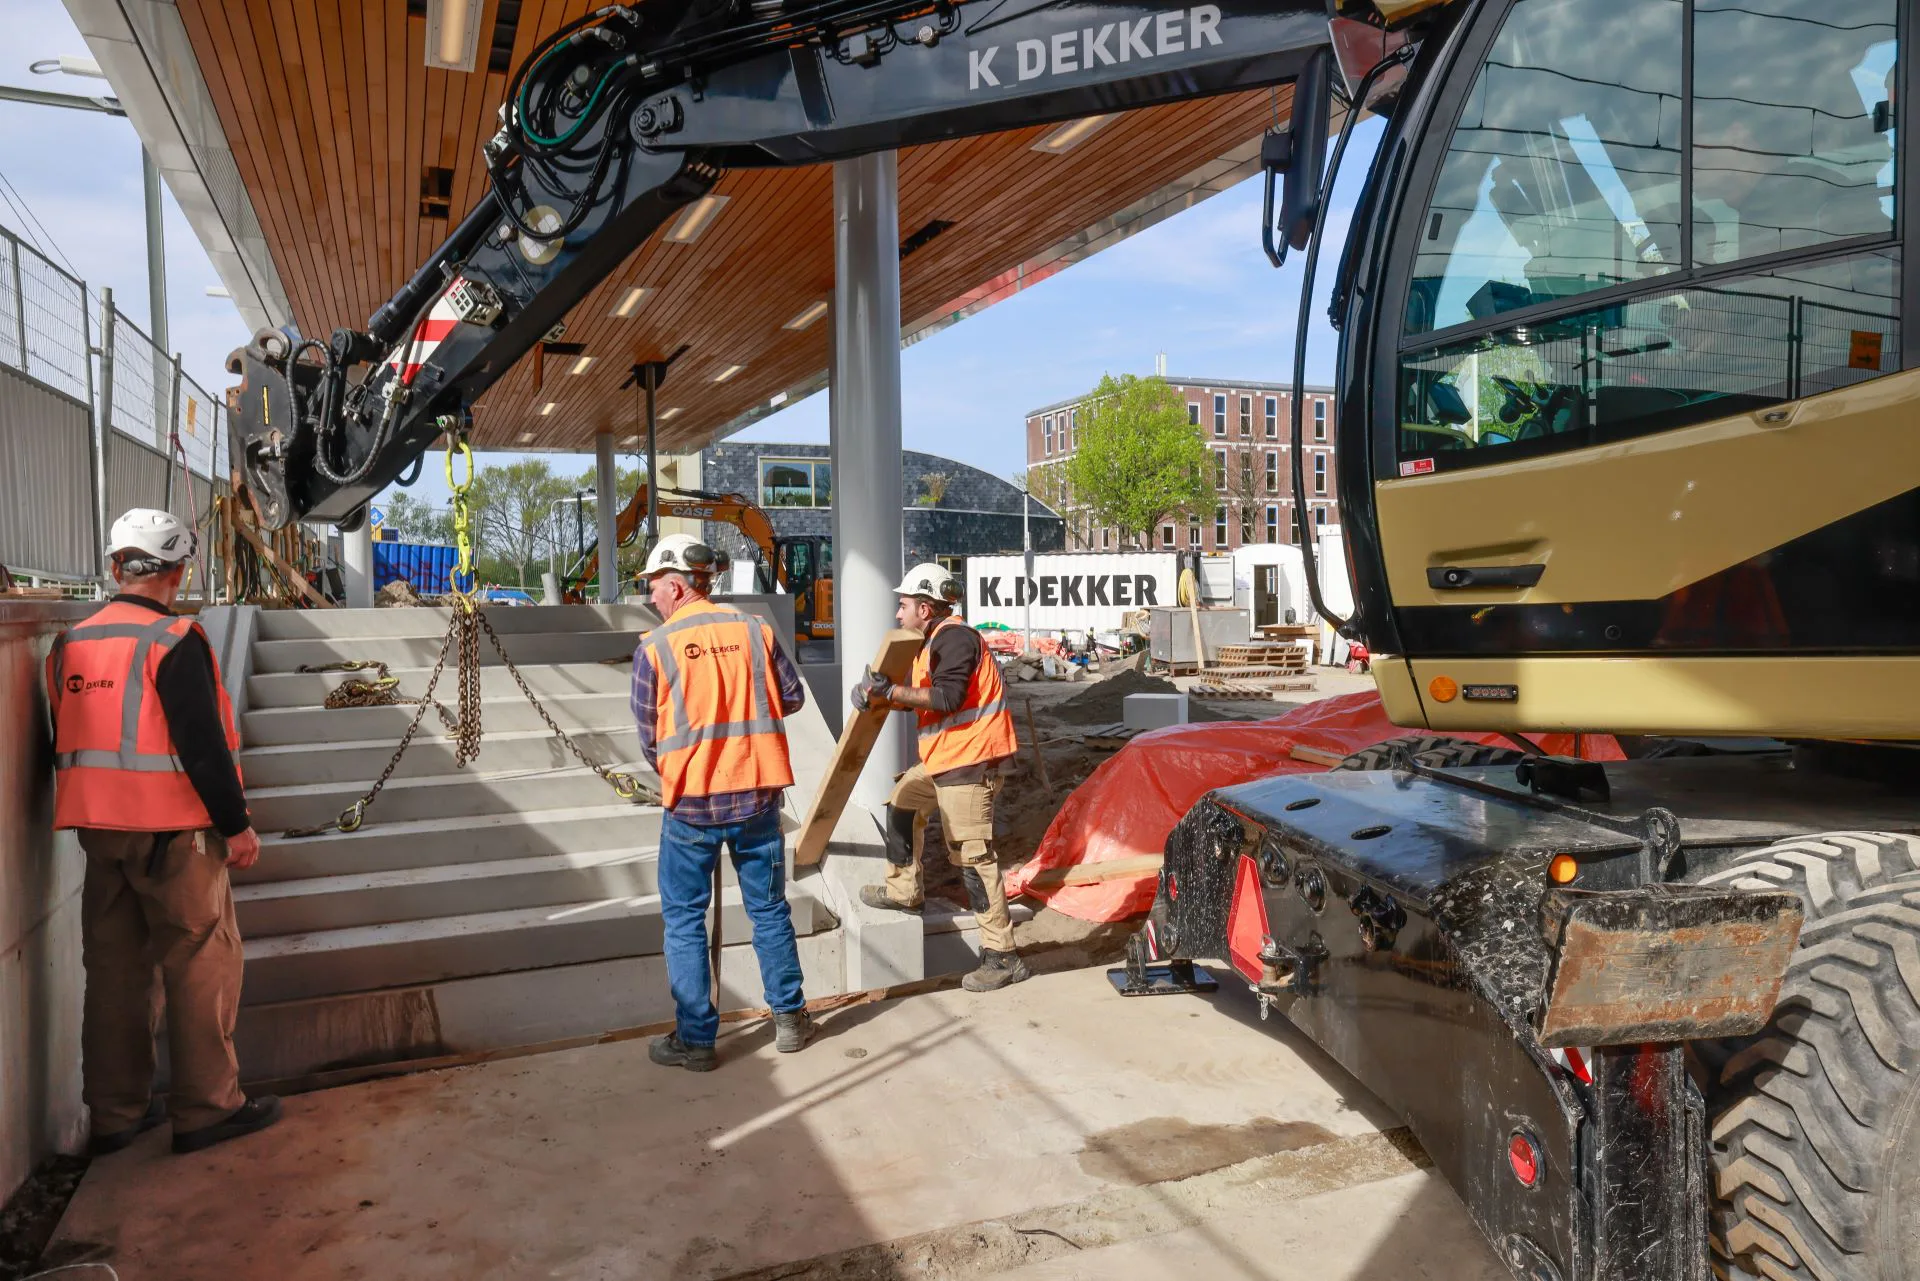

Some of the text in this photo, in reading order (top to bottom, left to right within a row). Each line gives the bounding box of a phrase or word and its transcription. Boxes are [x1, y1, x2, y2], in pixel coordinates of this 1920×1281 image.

[1016, 4, 1224, 81] DEKKER
[672, 506, 714, 517] CASE
[980, 574, 1158, 607] K.DEKKER
